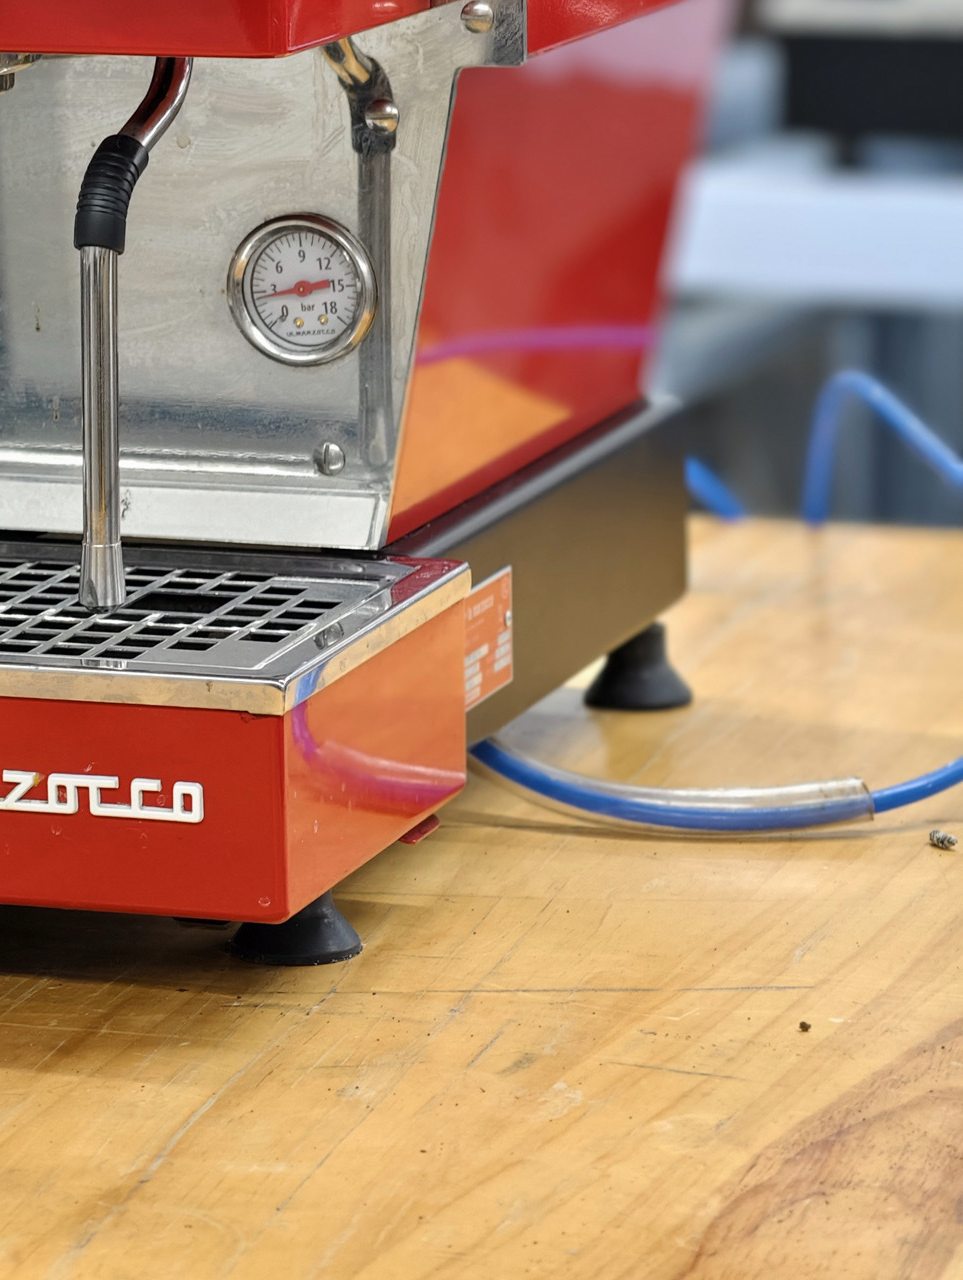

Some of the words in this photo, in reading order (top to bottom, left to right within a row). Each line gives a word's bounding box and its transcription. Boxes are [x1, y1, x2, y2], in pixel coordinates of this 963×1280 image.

[298, 249, 306, 263] 9
[275, 261, 283, 274] 6
[316, 257, 332, 271] 12
[270, 283, 277, 294] 3
[330, 279, 345, 293] 15
[300, 302, 315, 312] bar
[322, 301, 337, 315] 18
